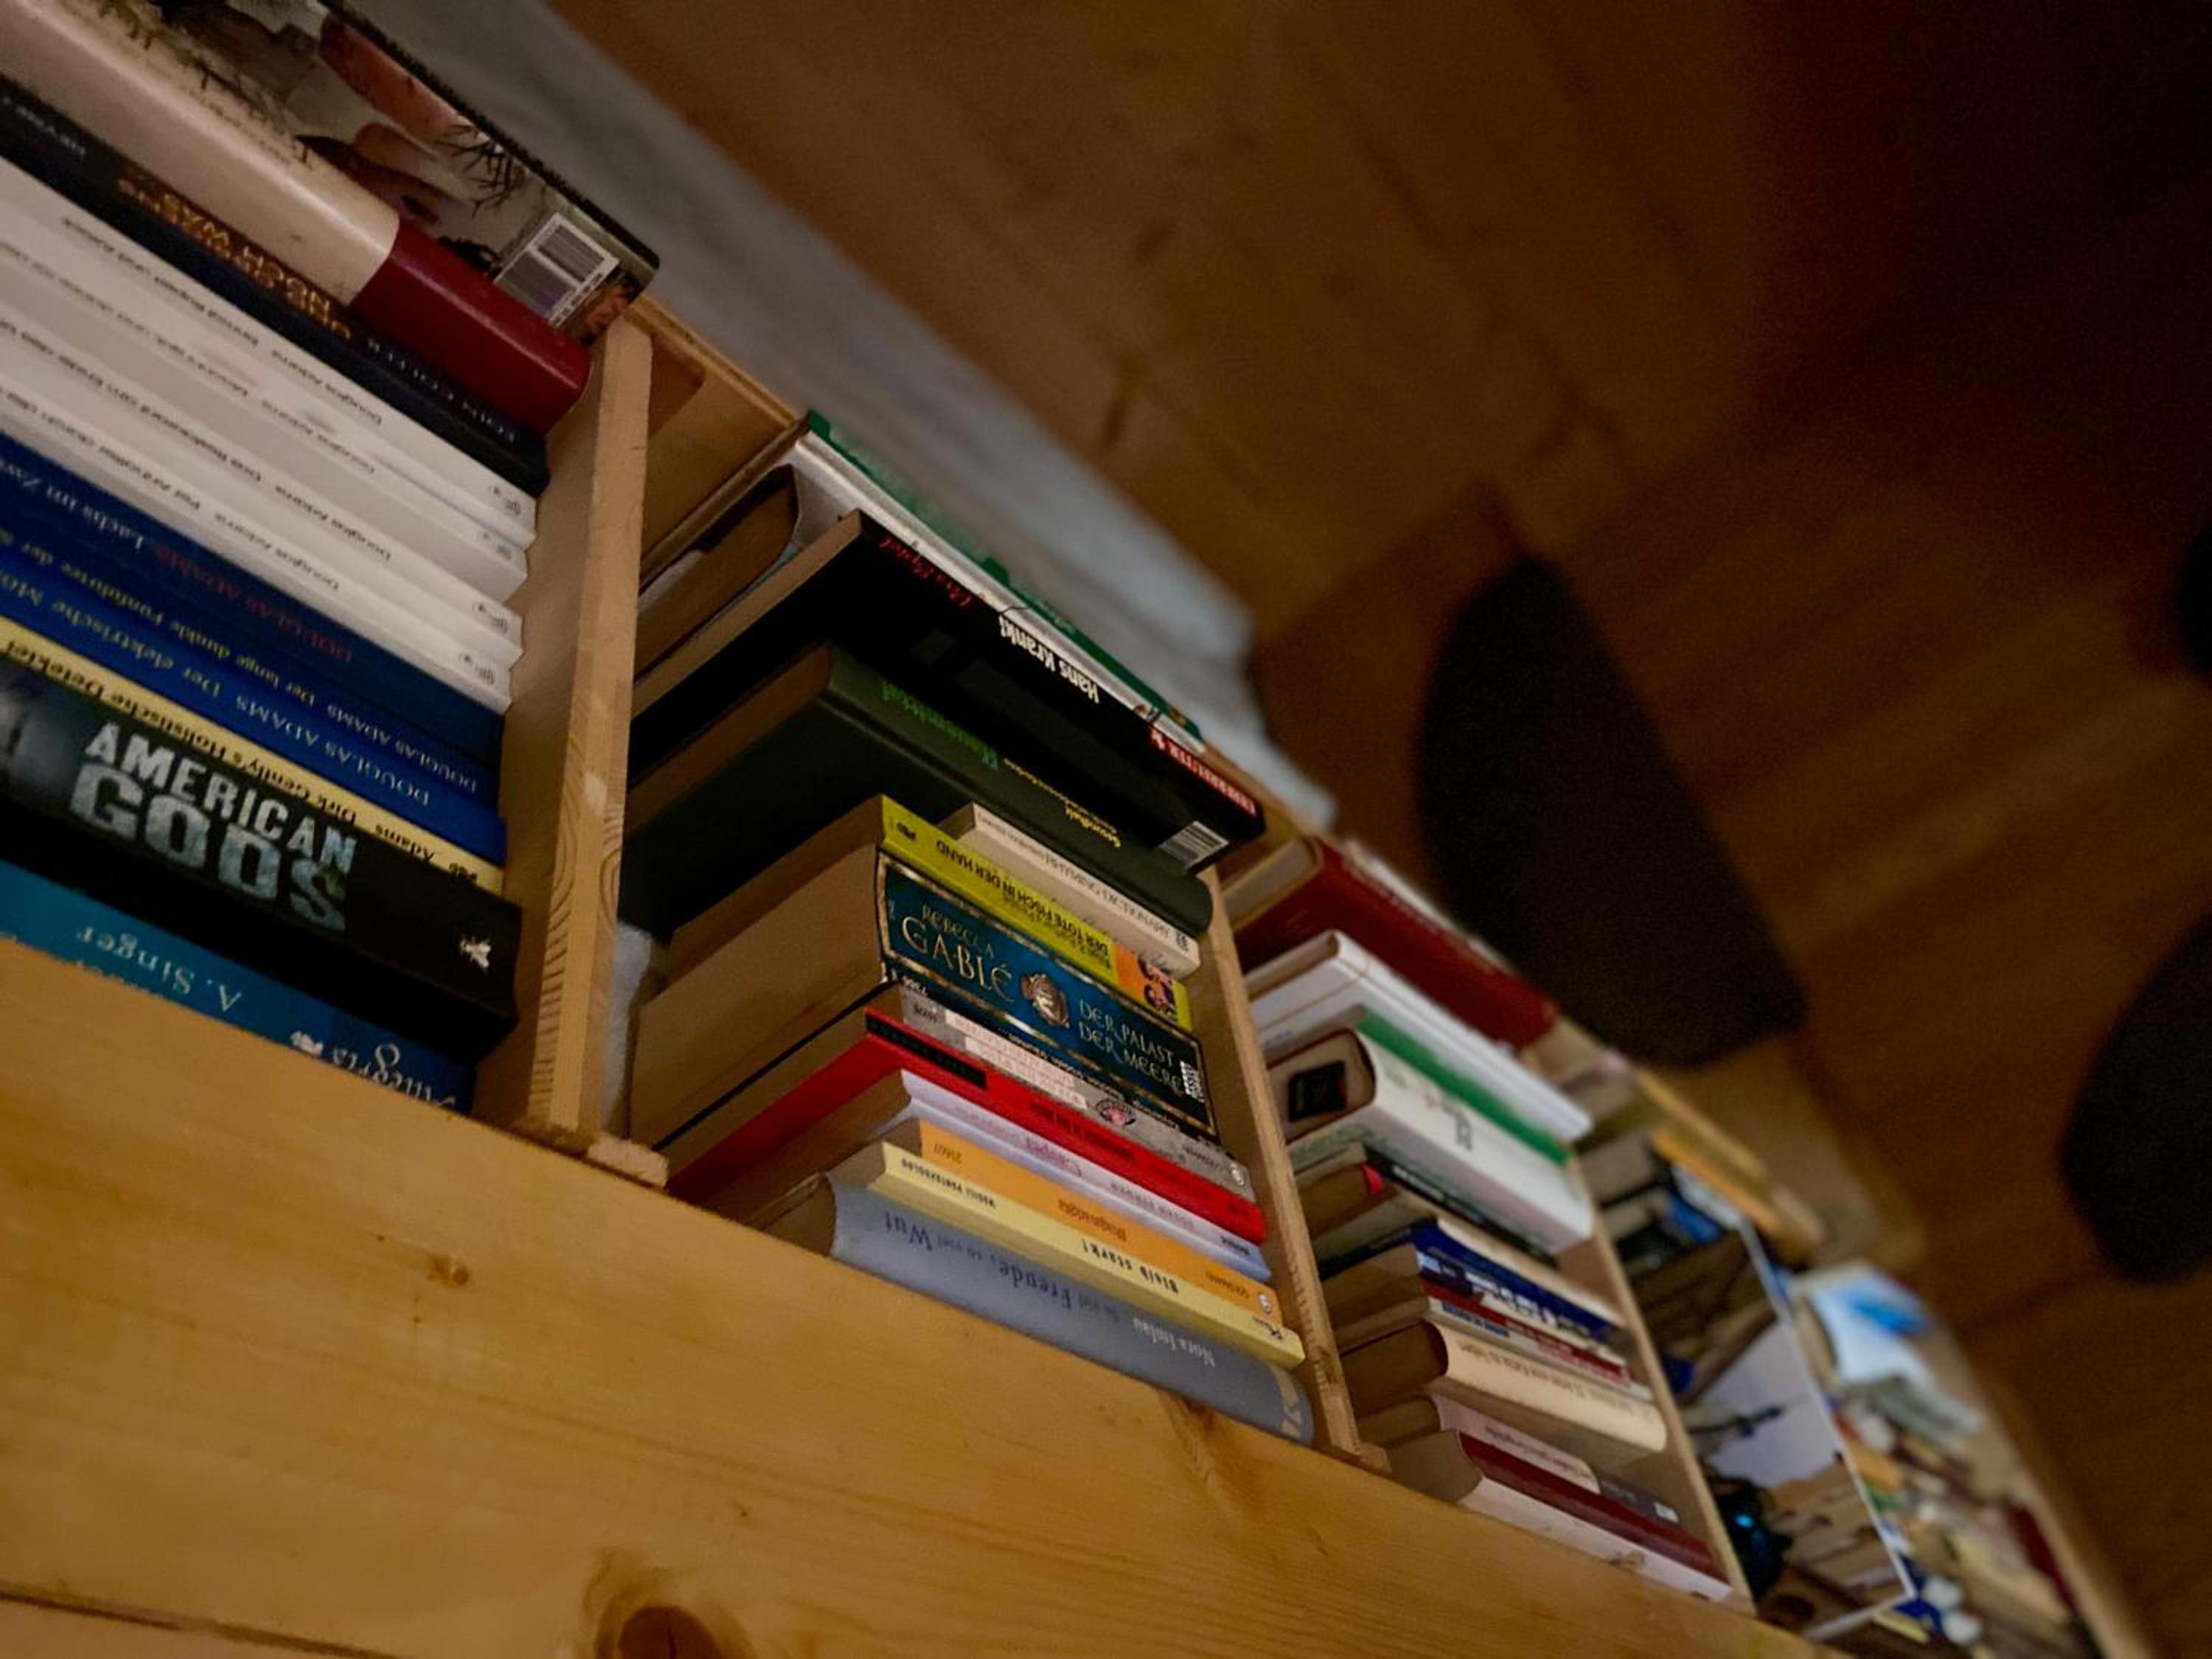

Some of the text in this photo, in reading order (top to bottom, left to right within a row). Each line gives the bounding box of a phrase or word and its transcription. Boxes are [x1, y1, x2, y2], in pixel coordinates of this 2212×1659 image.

[238, 243, 334, 313] NOCH
[268, 347, 324, 387] Adams
[258, 397, 314, 437] Adams
[271, 484, 329, 522] Adams
[212, 511, 272, 553] Adams
[271, 546, 341, 593] Douglas
[45, 596, 177, 675] elektrische
[176, 664, 224, 700] Der
[282, 679, 317, 706] Der
[1060, 660, 1100, 704] Hans
[111, 692, 227, 762] Holistische
[231, 691, 320, 748] ADAMS
[321, 700, 392, 747] ADAMS
[319, 737, 432, 807] DOUGLAS
[390, 737, 479, 794] DOUGLAS
[83, 720, 358, 876] AMERICAN
[310, 793, 358, 827] Dirk
[69, 762, 348, 933] GODS
[373, 821, 435, 866] Adams
[932, 838, 974, 870] HAND
[970, 863, 1001, 887] DER
[919, 900, 995, 959] REBECCA
[1079, 931, 1111, 958] DER
[74, 923, 197, 997] Singer
[901, 914, 1015, 1004] GABLÉ
[1079, 999, 1121, 1034] DER
[1122, 1023, 1175, 1066] PALAST
[1079, 1023, 1125, 1065] DER
[1124, 1050, 1183, 1098] MEERE
[884, 1211, 933, 1253] Wut
[988, 1253, 1073, 1310] Freude,
[1081, 1239, 1180, 1295] Bleib stark!
[1175, 1332, 1216, 1368] Nora
